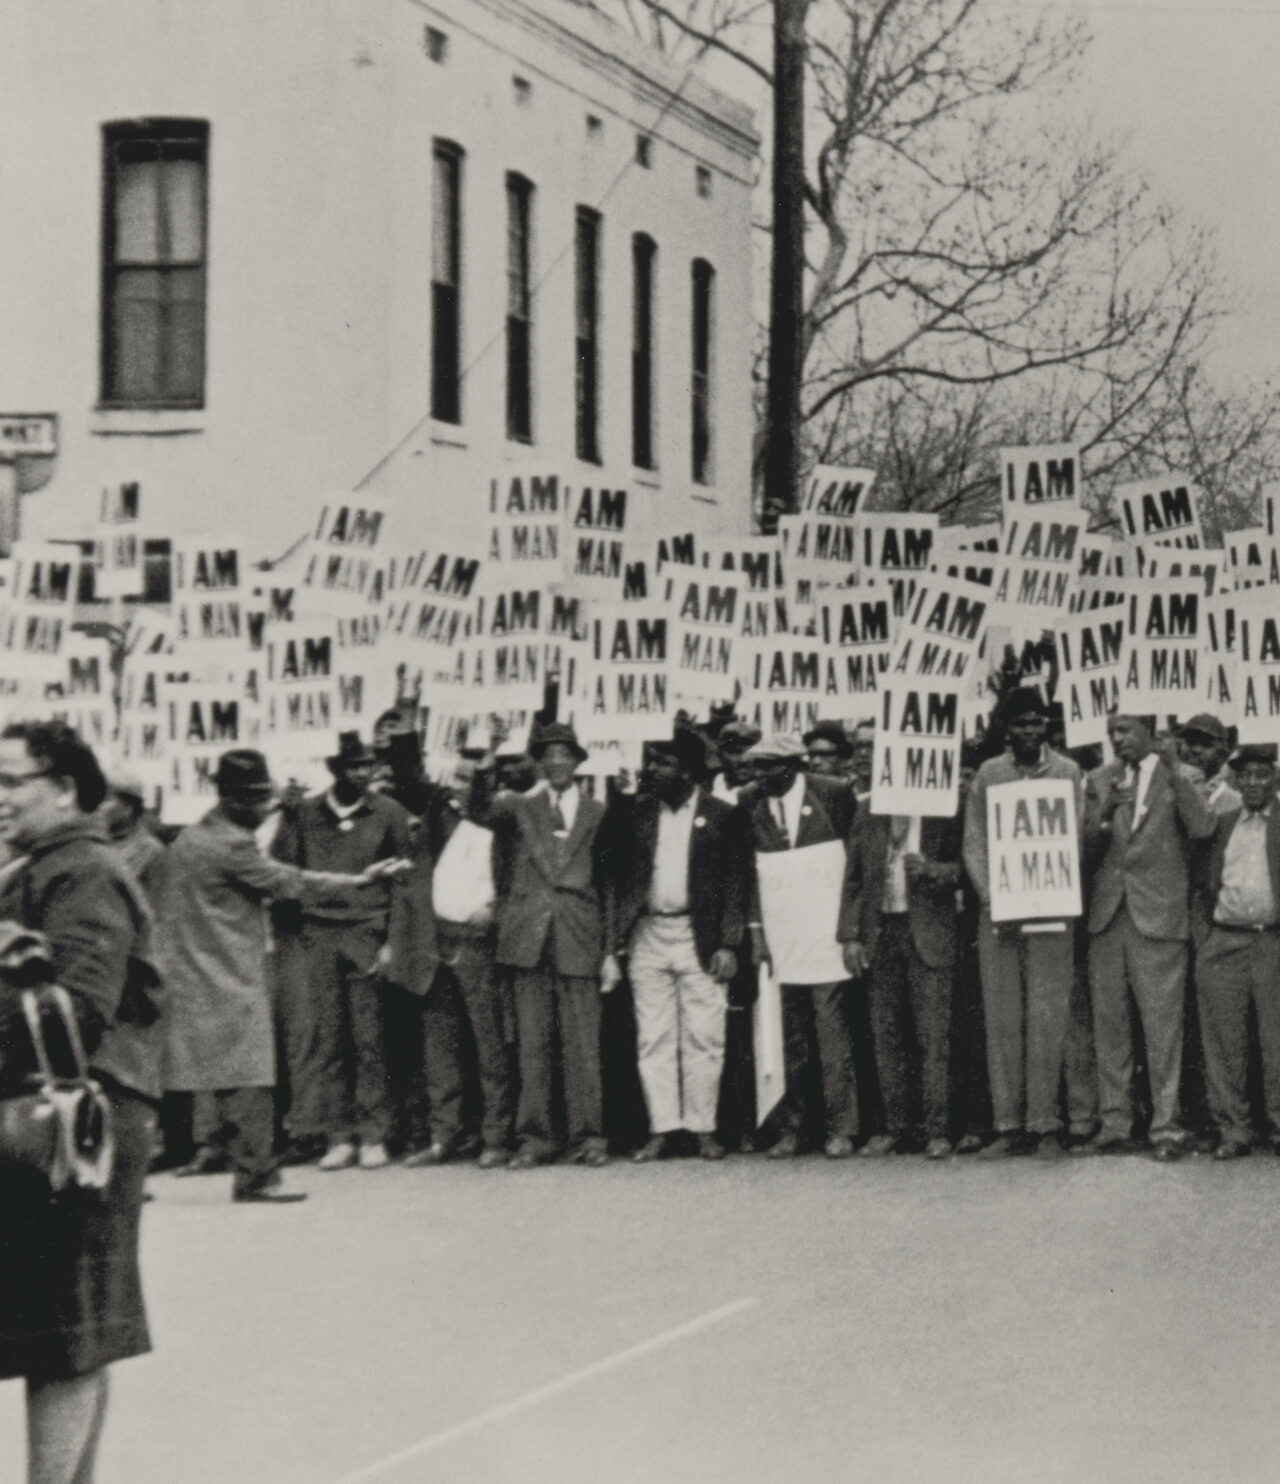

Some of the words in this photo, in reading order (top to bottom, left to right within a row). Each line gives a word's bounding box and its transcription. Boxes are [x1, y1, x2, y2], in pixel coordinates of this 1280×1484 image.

[506, 475, 558, 513] AM
[806, 478, 817, 511] I
[817, 481, 864, 514] AM
[1008, 463, 1015, 500] I
[1025, 458, 1074, 500] AM
[331, 506, 384, 546] AM
[575, 487, 627, 528] AM
[1123, 500, 1136, 535] I
[1143, 487, 1192, 532] AM
[489, 526, 500, 561] A
[511, 525, 557, 560] MAN
[575, 537, 622, 578] MAN
[797, 523, 808, 557] A
[814, 524, 853, 562] MAN
[864, 528, 871, 566] I
[881, 528, 932, 567] AM
[1006, 521, 1018, 555] I
[1021, 522, 1078, 559] AM
[28, 561, 71, 601] AM
[194, 549, 239, 589] AM
[424, 553, 480, 596] AM
[997, 568, 1009, 600] A
[1018, 569, 1068, 607] MAN
[201, 602, 240, 638] MAN
[491, 591, 540, 636] AM
[680, 583, 737, 624] AM
[823, 606, 830, 644] I
[840, 601, 888, 643] AM
[911, 588, 927, 625] I
[926, 592, 985, 640] AM
[1130, 595, 1137, 635] I
[1146, 594, 1198, 635] AM
[415, 603, 461, 646] MAN
[594, 619, 601, 660] I
[611, 619, 667, 660] AM
[1242, 620, 1249, 661] I
[284, 637, 331, 678] AM
[495, 645, 536, 684] MAN
[681, 632, 732, 674] MAN
[754, 654, 761, 689] I
[769, 652, 818, 688] AM
[895, 639, 912, 674] A
[916, 642, 968, 677] MAN
[1061, 632, 1071, 671] I
[1127, 649, 1139, 689] A
[1152, 649, 1196, 689] MAN
[594, 674, 606, 714] A
[618, 674, 666, 713] MAN
[826, 657, 837, 695] A
[1245, 676, 1257, 716] A
[186, 701, 238, 741] AM
[288, 691, 331, 732] MAN
[774, 701, 818, 733] MAN
[883, 690, 891, 731] I
[901, 691, 957, 734] AM
[1071, 684, 1082, 722] A
[880, 747, 892, 787] A
[906, 748, 954, 789] MAN
[997, 803, 1003, 840] I
[1013, 797, 1067, 838] AM
[1001, 856, 1010, 892] A
[1022, 851, 1071, 892] MAN
